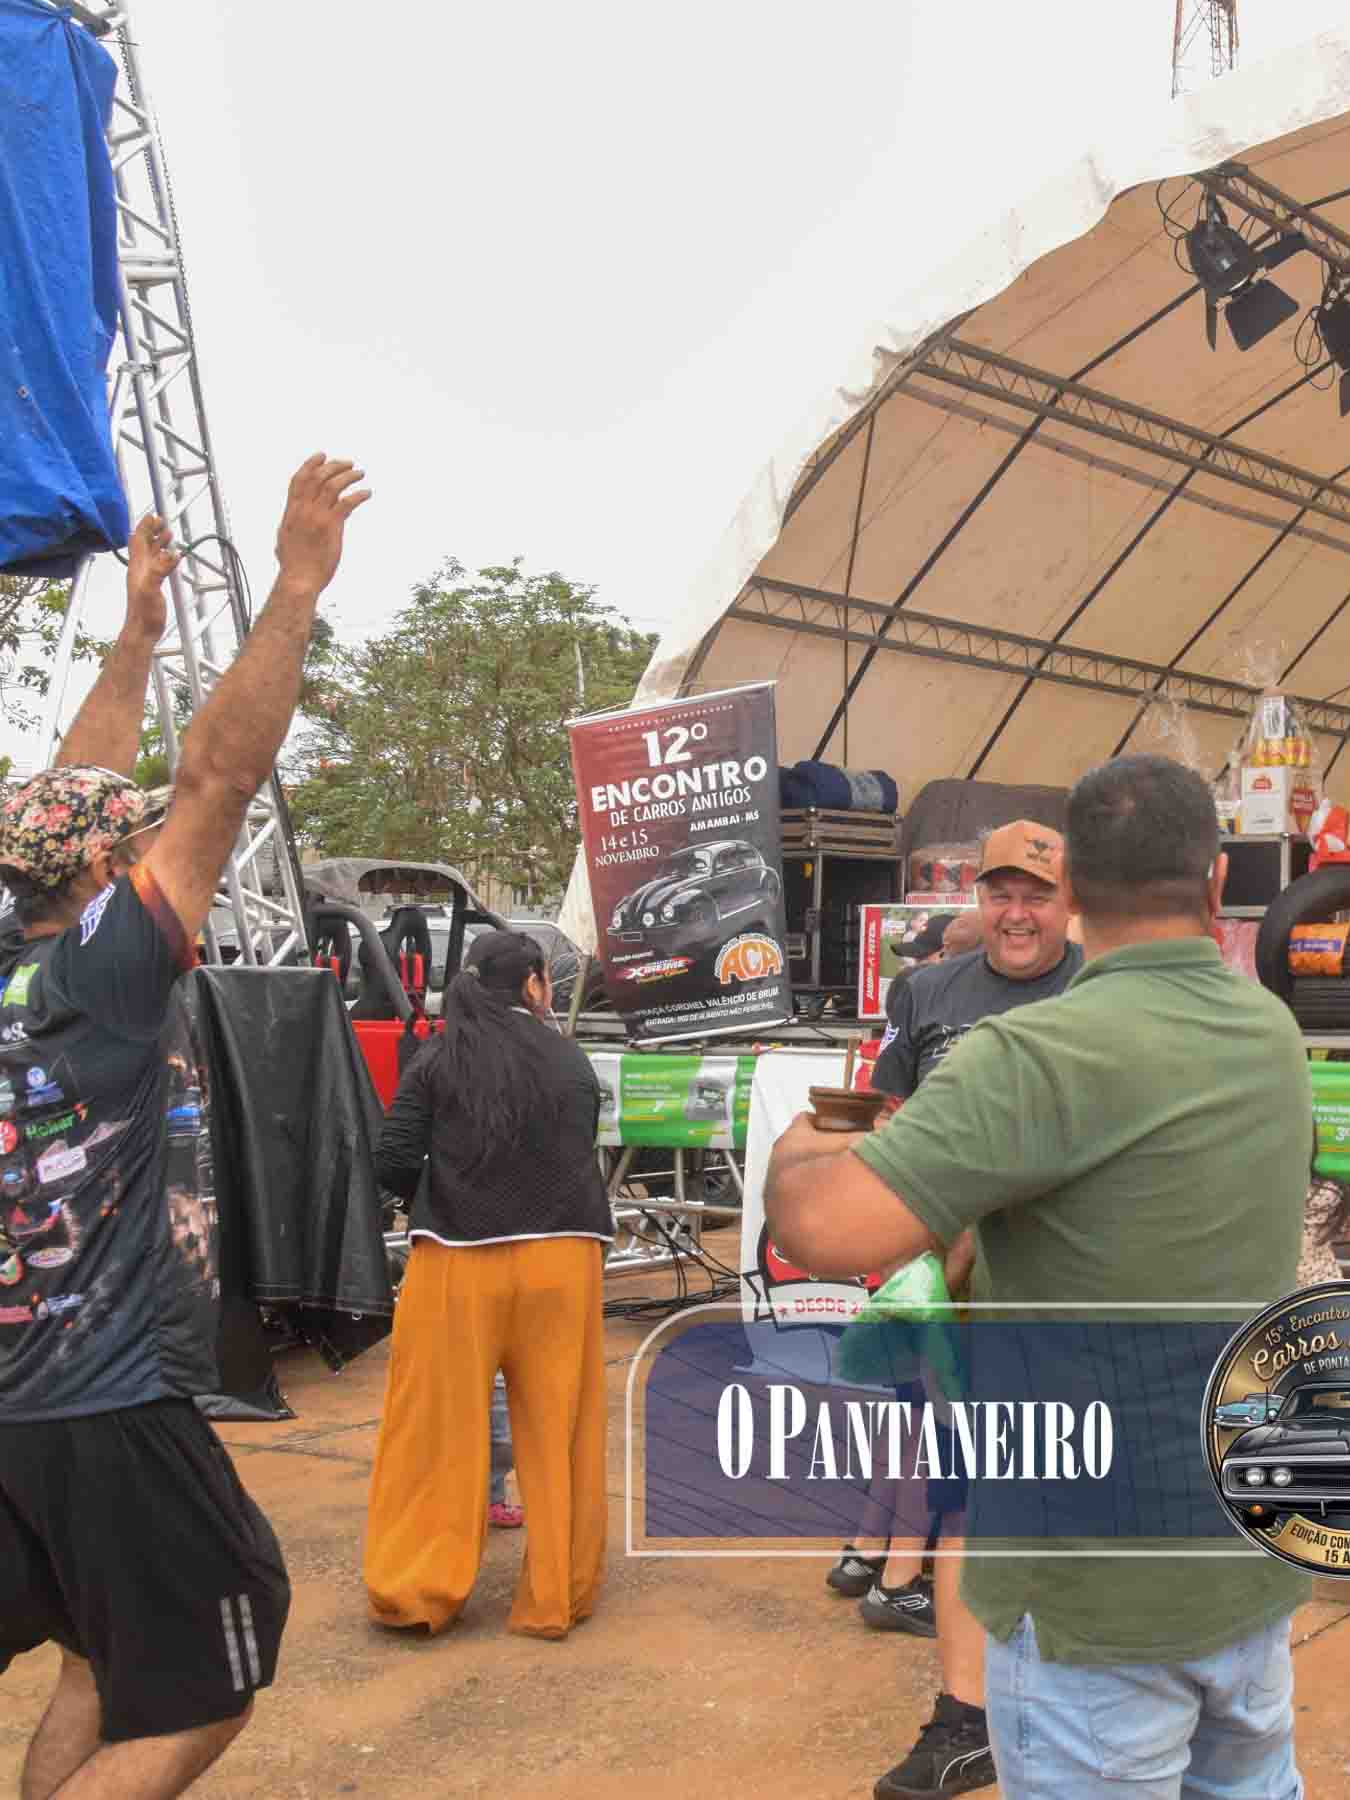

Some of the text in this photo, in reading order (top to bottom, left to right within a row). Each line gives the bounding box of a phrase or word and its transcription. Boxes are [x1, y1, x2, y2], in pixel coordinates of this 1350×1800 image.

[591, 755, 768, 813] ENCONTRO
[610, 785, 752, 828] DE CARROS ANTIGOS
[745, 809, 760, 821] MS
[600, 828, 649, 851] 14 e 15
[594, 846, 660, 868] NOVEMBRO
[746, 991, 758, 1001] DE
[794, 1297, 846, 1313] DESDE
